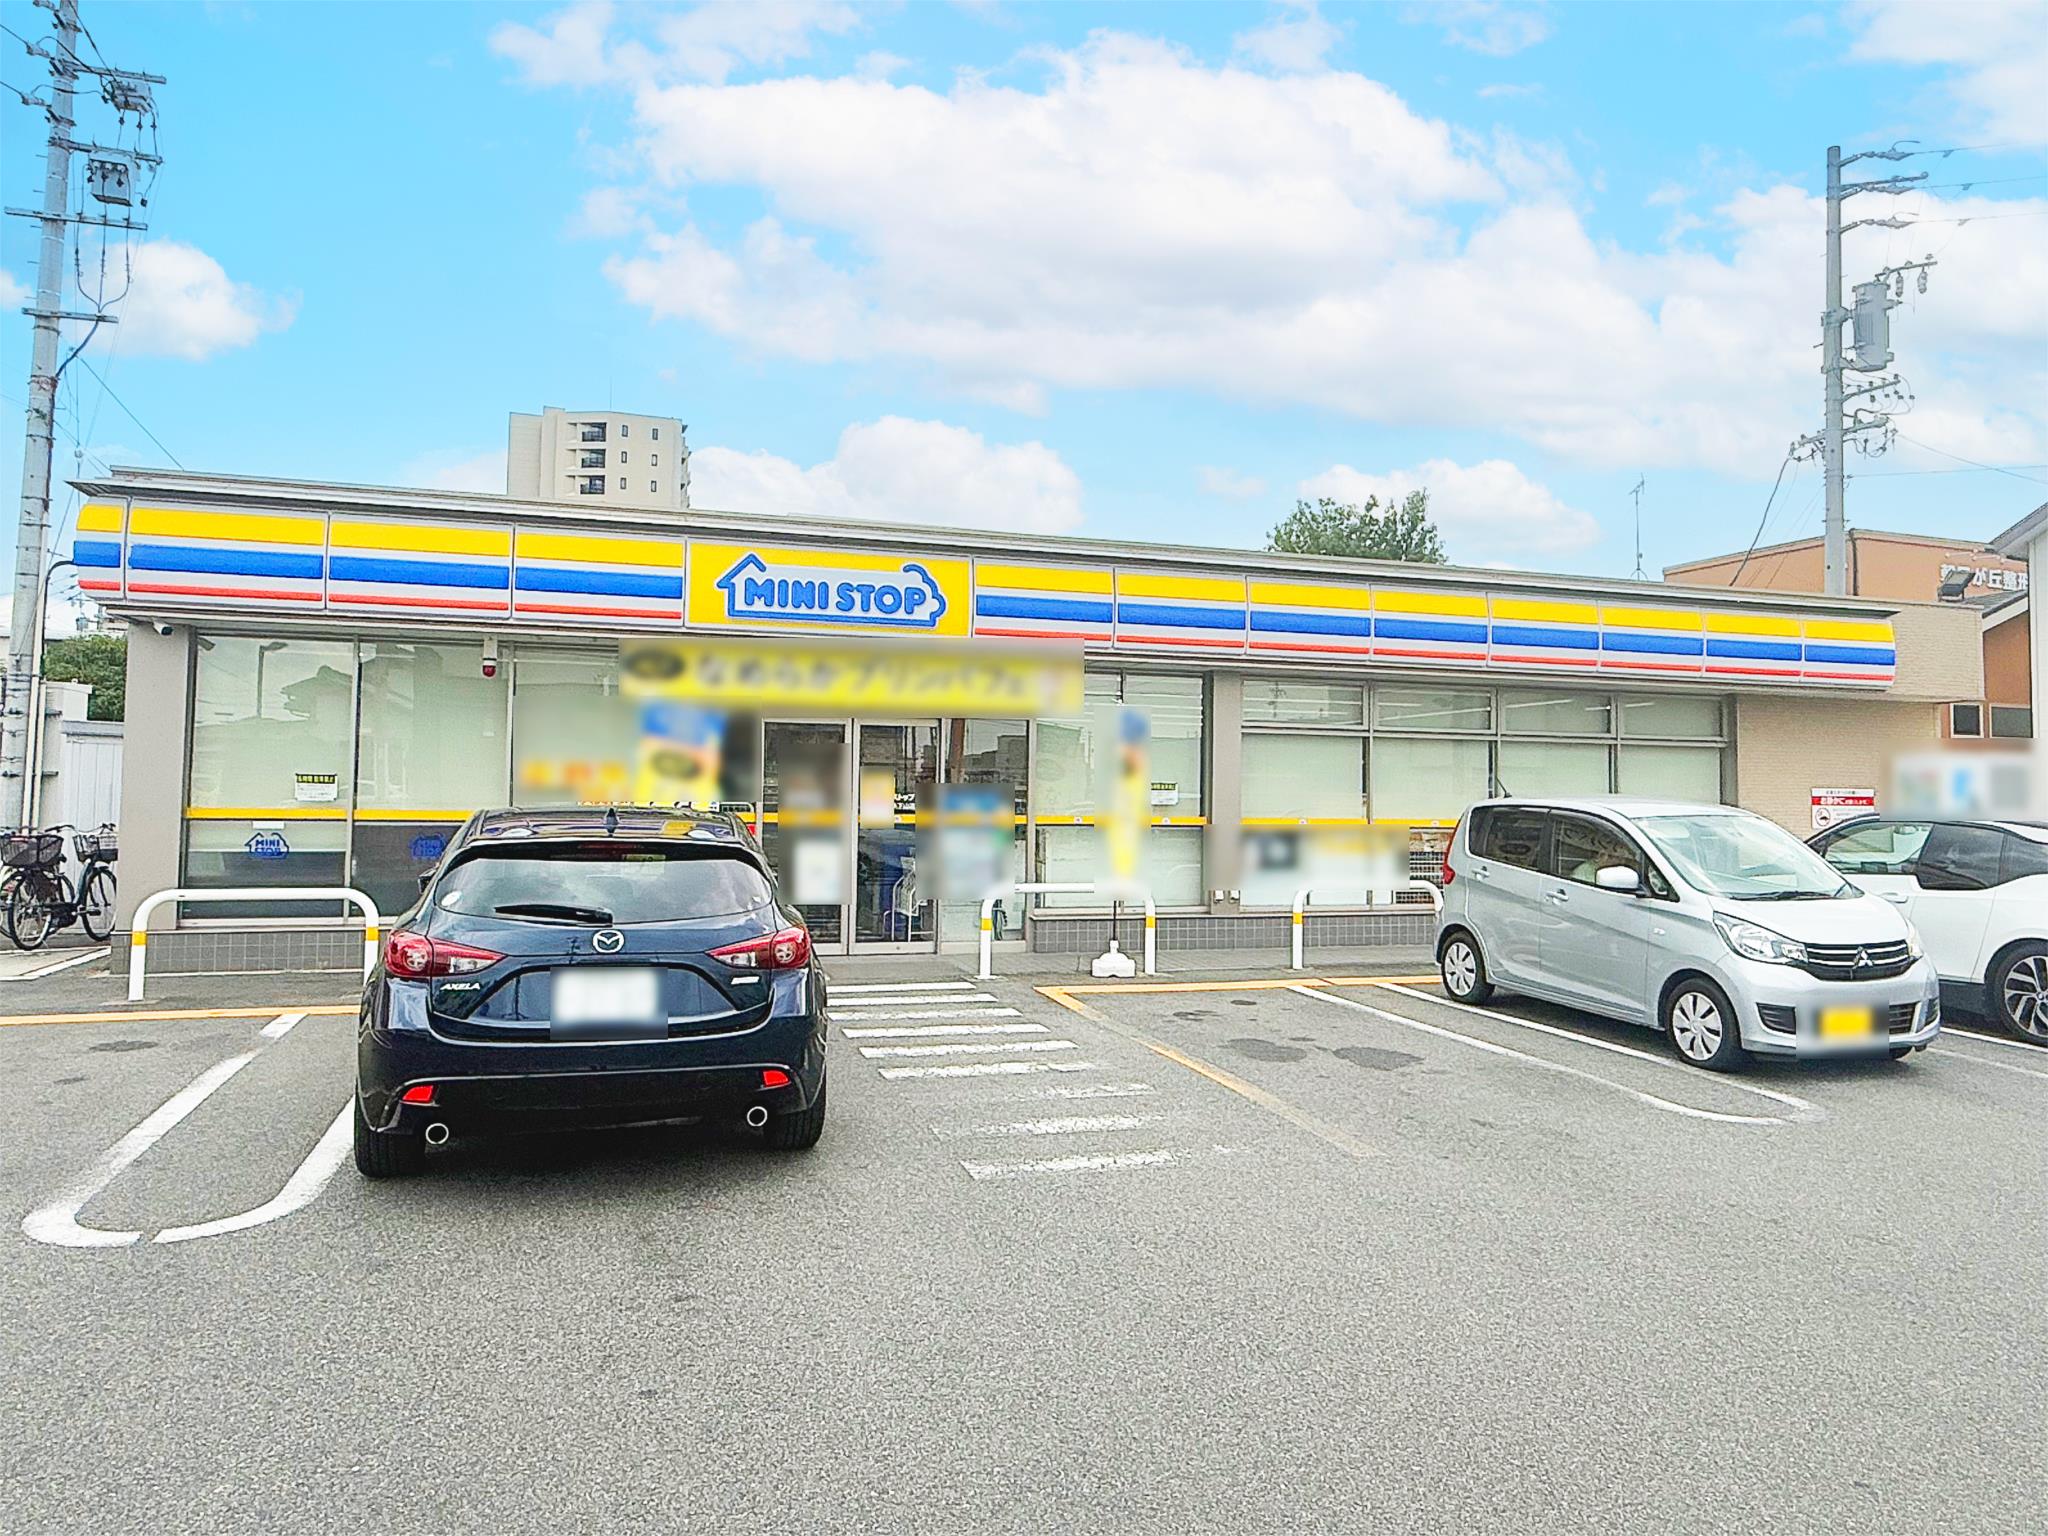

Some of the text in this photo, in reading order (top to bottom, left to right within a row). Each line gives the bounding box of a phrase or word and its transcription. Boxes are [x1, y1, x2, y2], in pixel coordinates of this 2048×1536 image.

[744, 577, 927, 615] MINI STOP
[440, 982, 481, 991] AXELA
